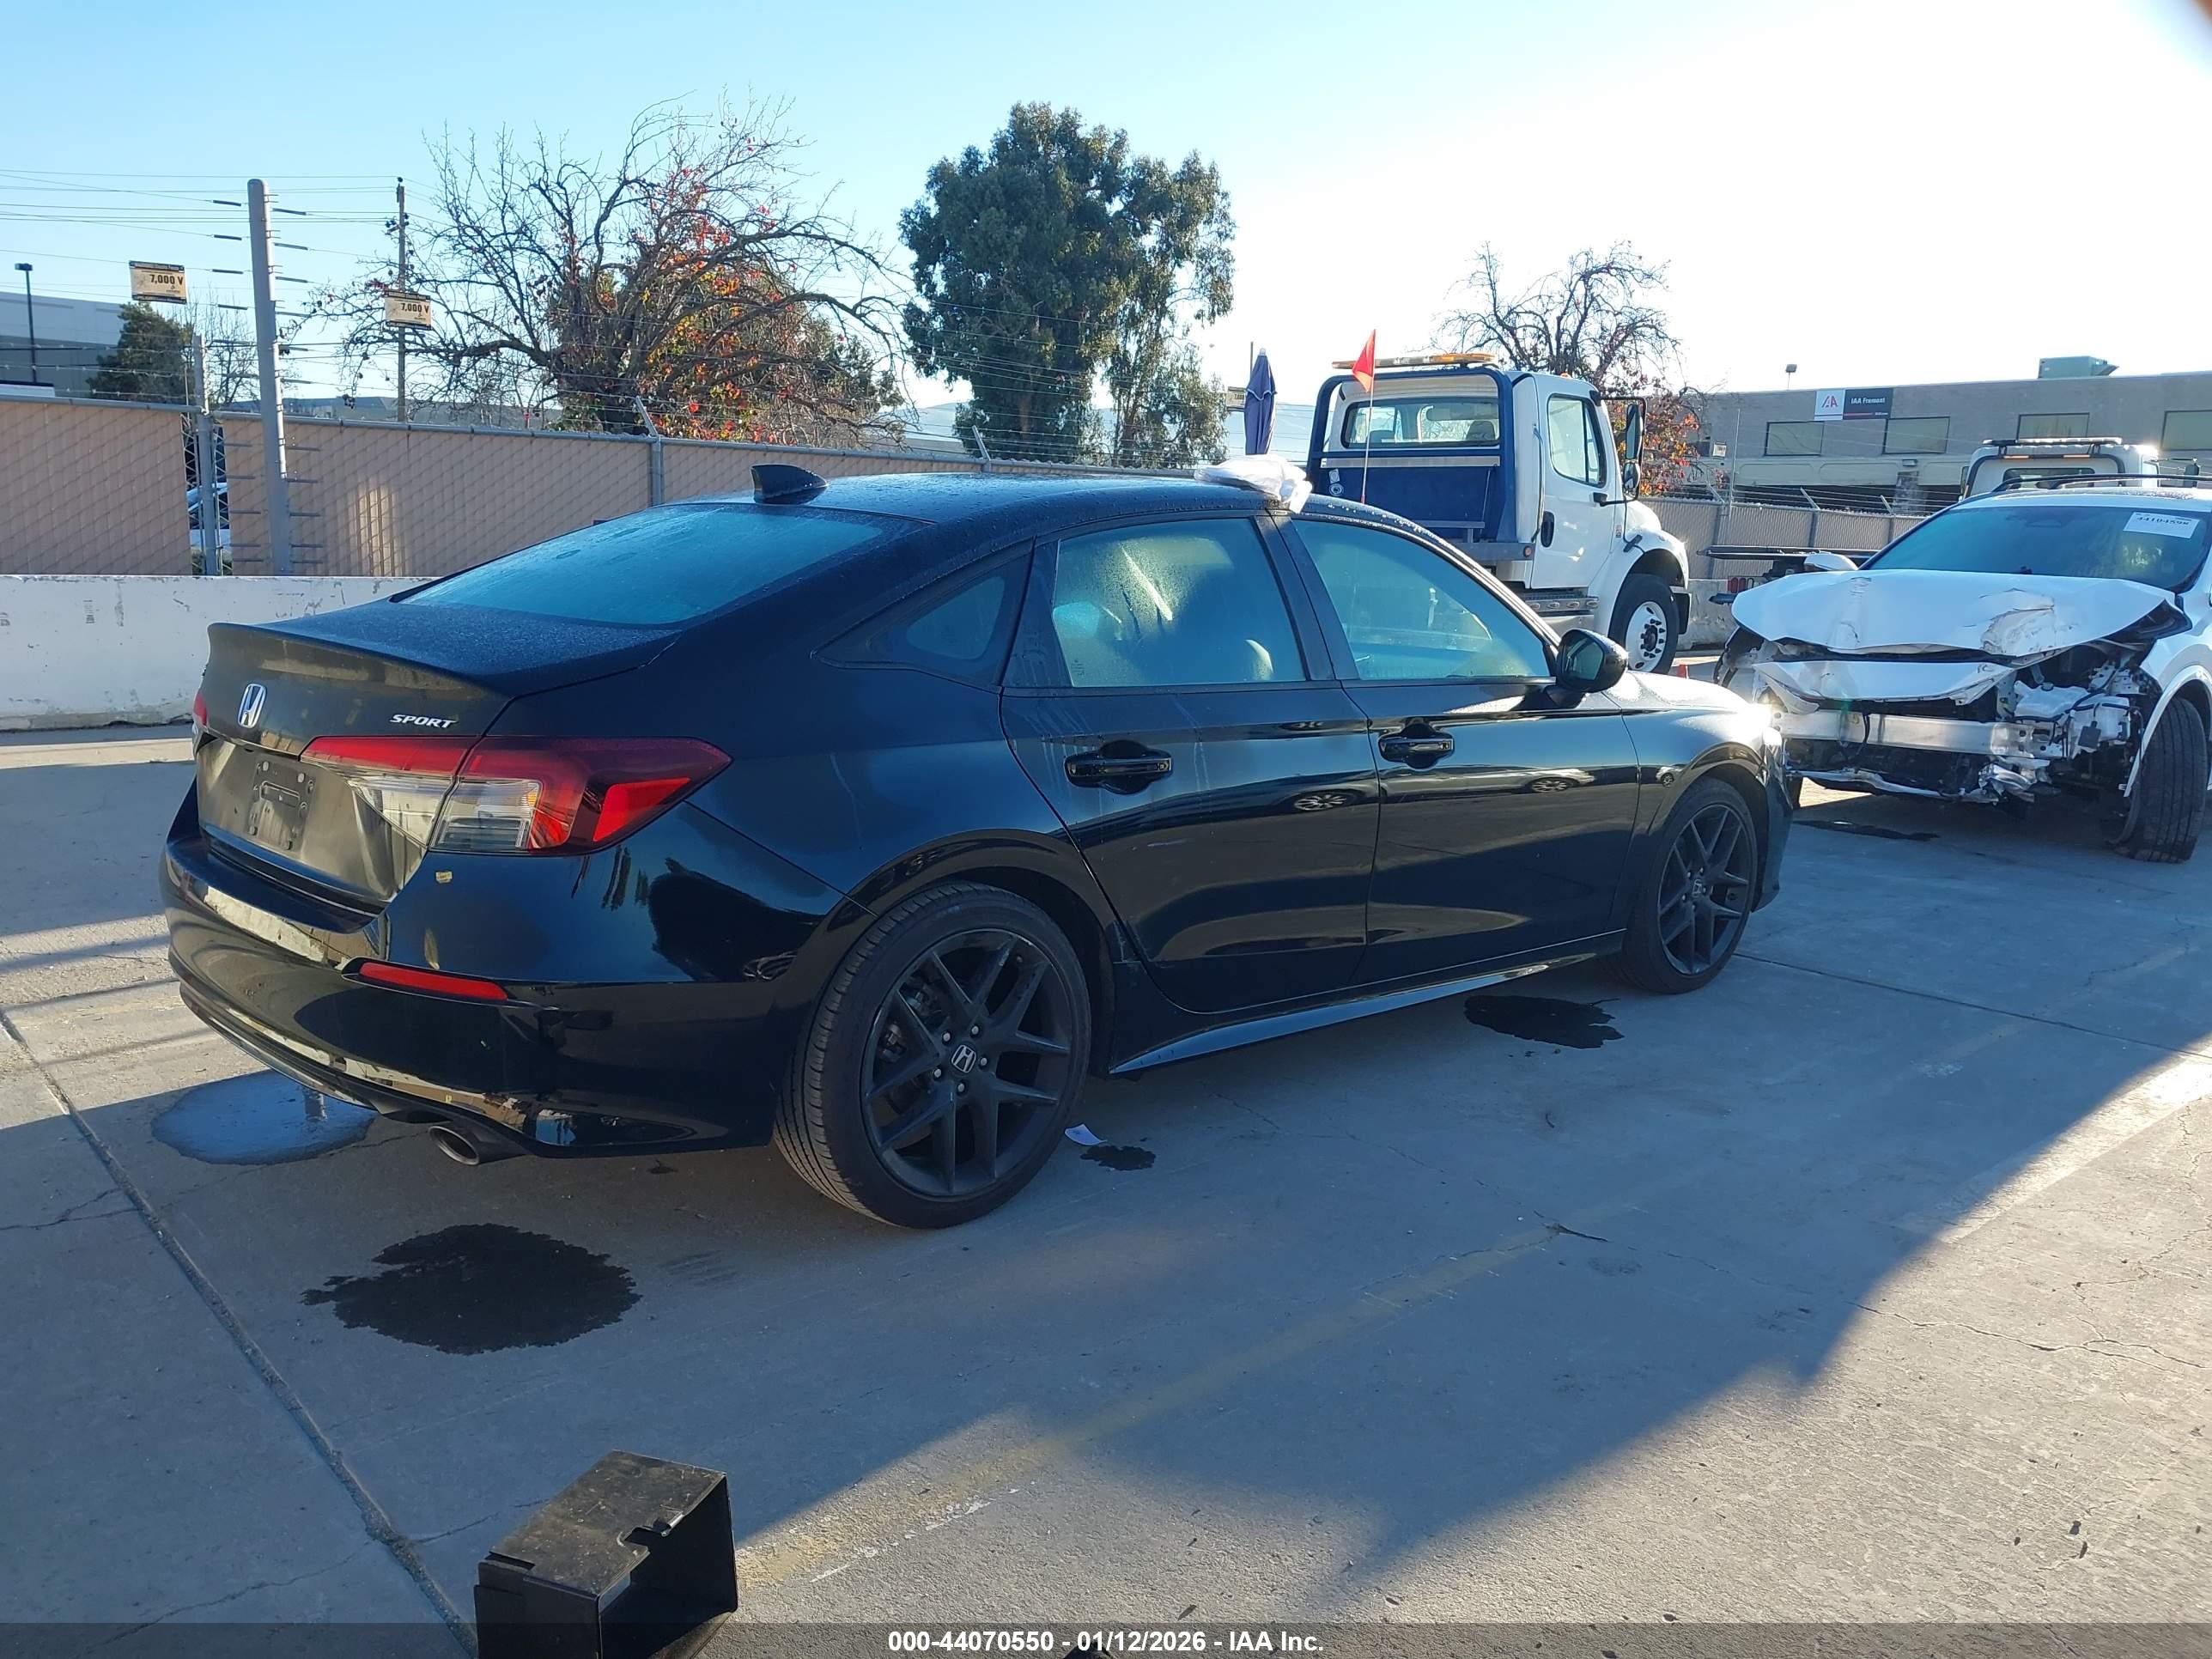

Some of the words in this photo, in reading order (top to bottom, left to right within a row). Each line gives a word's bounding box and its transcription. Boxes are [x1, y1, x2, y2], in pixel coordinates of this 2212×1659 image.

[149, 274, 175, 284] 7,000
[177, 276, 184, 285] V
[400, 302, 422, 313] 7,000
[423, 305, 429, 313] V
[389, 714, 457, 728] SPORT
